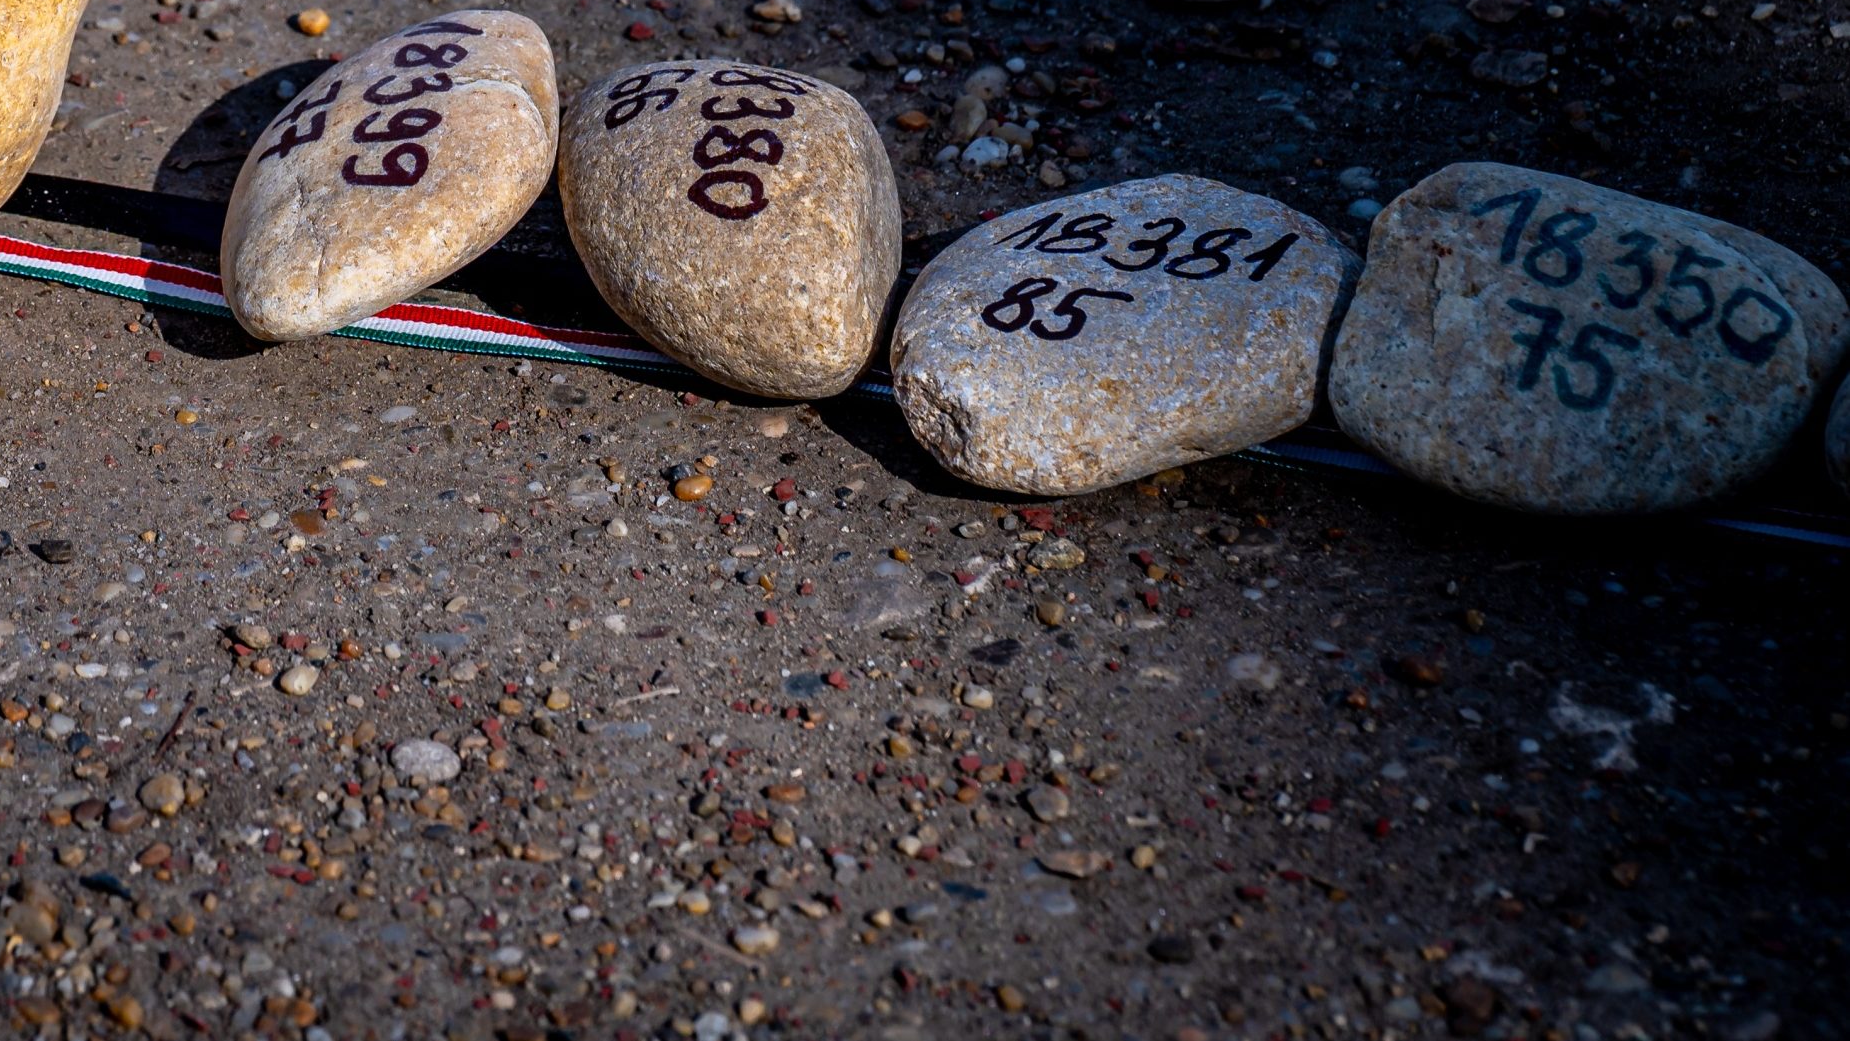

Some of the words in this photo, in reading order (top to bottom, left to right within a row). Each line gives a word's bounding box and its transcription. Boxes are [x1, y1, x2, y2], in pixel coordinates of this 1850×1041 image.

[257, 79, 343, 162] 77
[341, 20, 485, 186] 18399
[603, 68, 696, 130] 66
[993, 212, 1300, 282] 18381
[1470, 187, 1793, 366] 18350
[980, 277, 1135, 341] 85
[1506, 297, 1642, 412] 75
